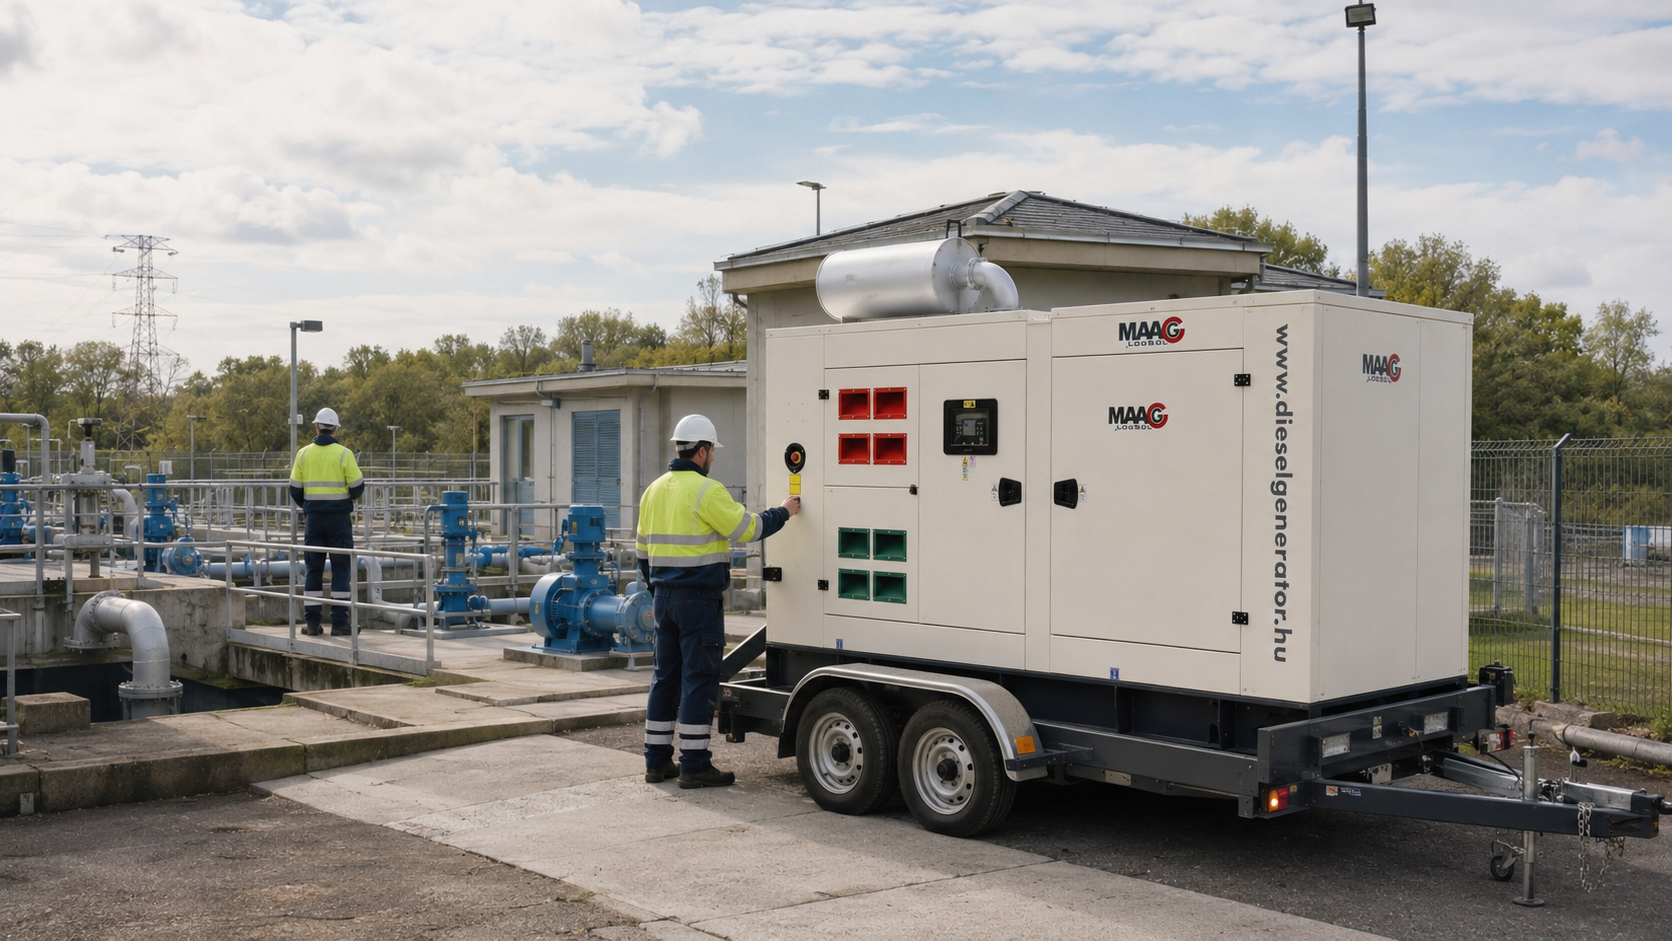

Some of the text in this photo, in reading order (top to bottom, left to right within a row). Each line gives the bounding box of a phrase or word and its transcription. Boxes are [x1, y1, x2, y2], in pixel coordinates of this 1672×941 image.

[1118, 316, 1185, 344] MAAG
[1362, 353, 1402, 382] MAAG
[1108, 402, 1169, 429] MAAG
[1270, 323, 1293, 662] www.dieselgenerator.hu
